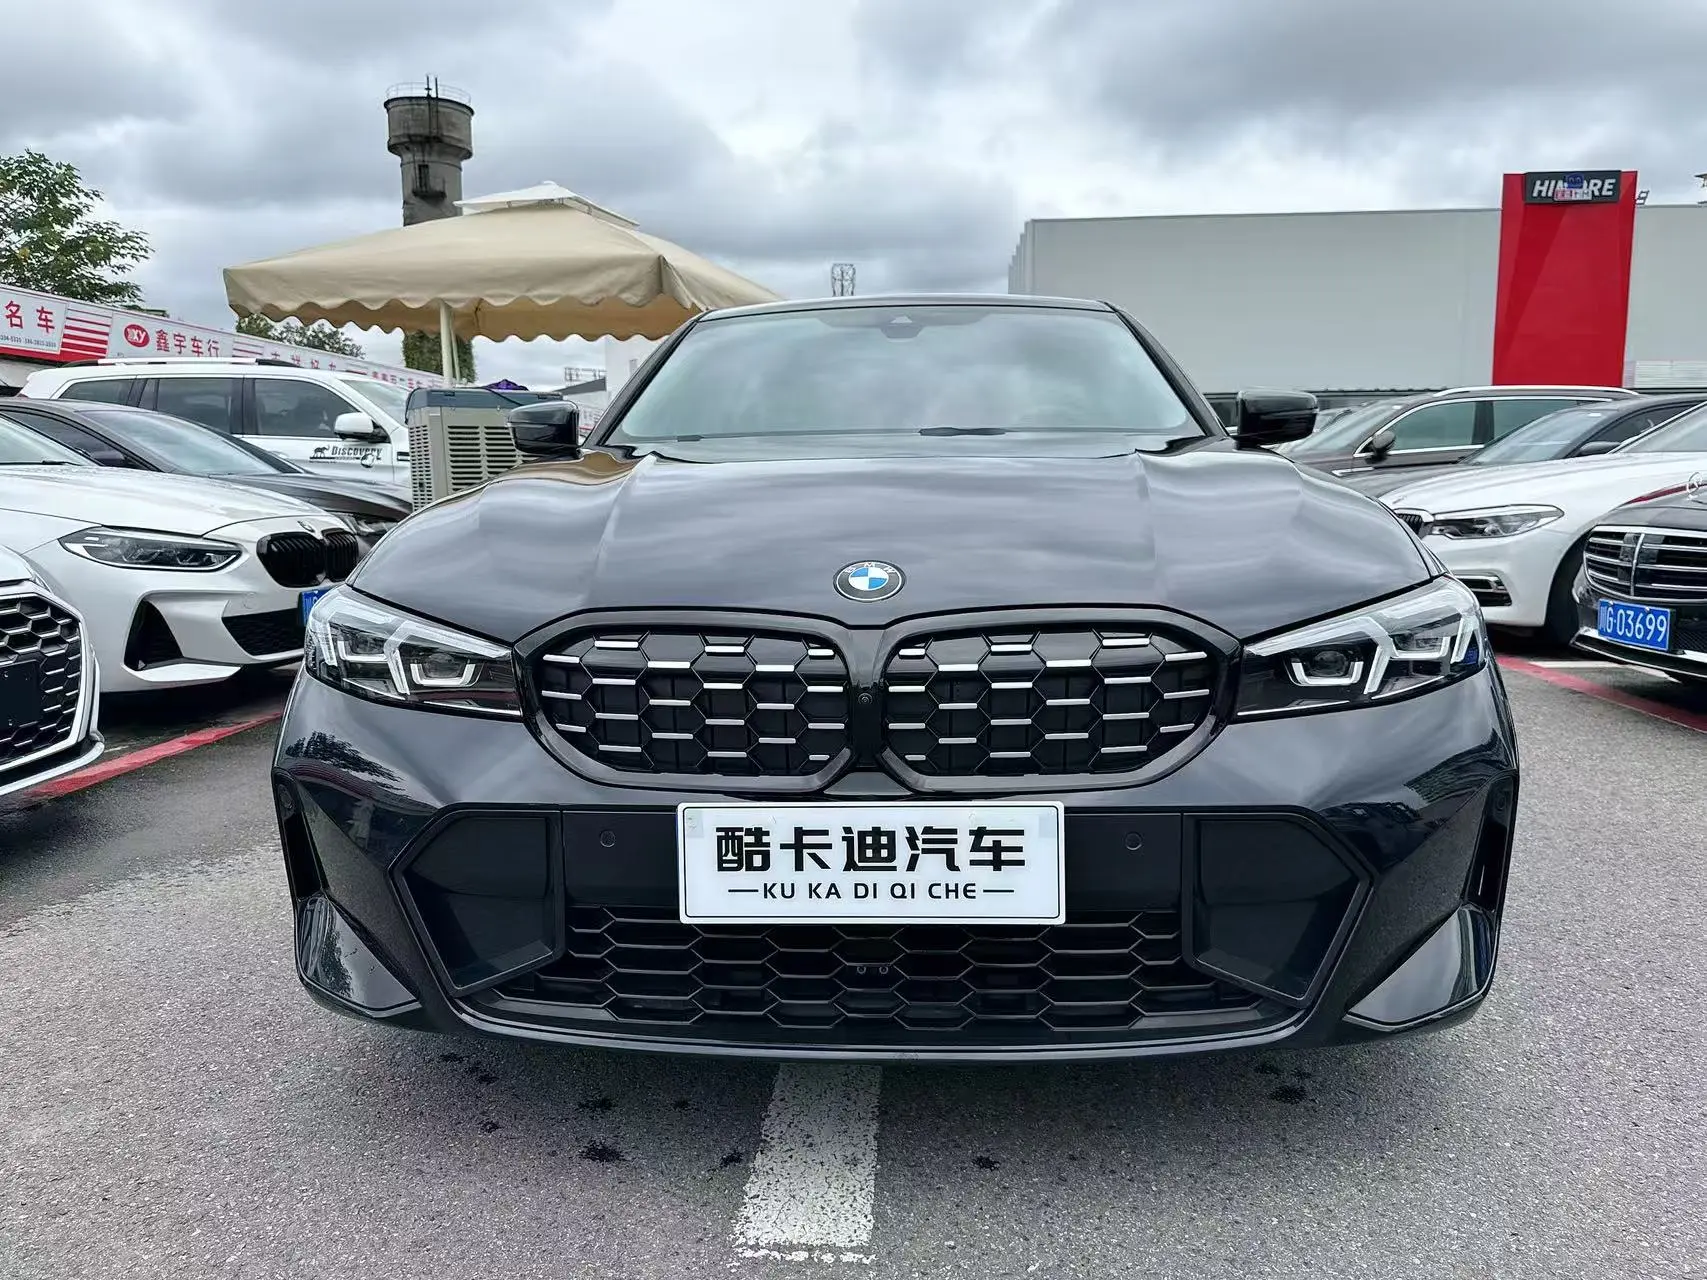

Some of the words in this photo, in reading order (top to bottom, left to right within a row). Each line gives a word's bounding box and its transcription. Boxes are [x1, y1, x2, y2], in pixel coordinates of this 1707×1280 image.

[155, 329, 221, 358] 鑫宇车行
[715, 825, 1026, 872] 酷卡迪汽车
[763, 882, 795, 899] KU
[808, 882, 842, 899] KA
[853, 882, 878, 899] DI
[889, 882, 915, 899] QI
[927, 882, 977, 899] CHE
